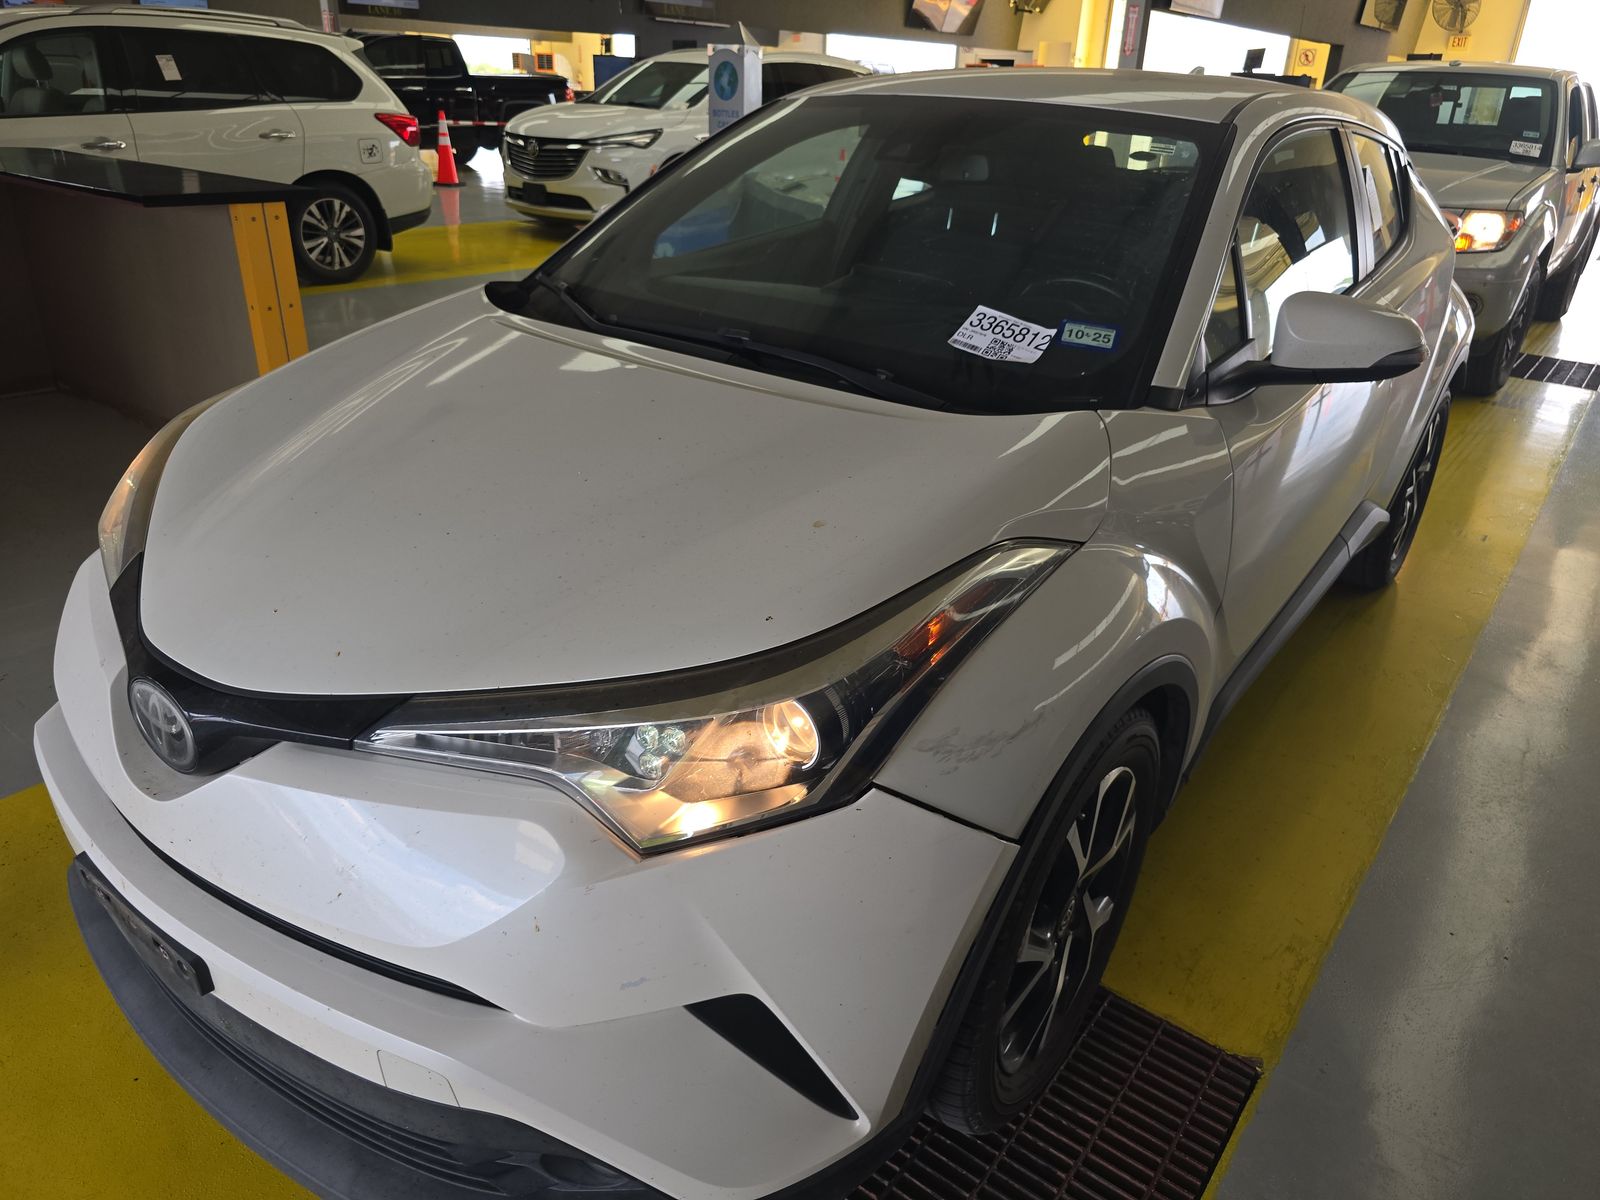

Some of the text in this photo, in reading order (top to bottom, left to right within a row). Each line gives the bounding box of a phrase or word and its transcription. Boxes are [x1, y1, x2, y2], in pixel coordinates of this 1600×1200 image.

[1452, 36, 1467, 47] EXIT
[956, 331, 974, 341] DLR
[969, 312, 1053, 351] 3365812
